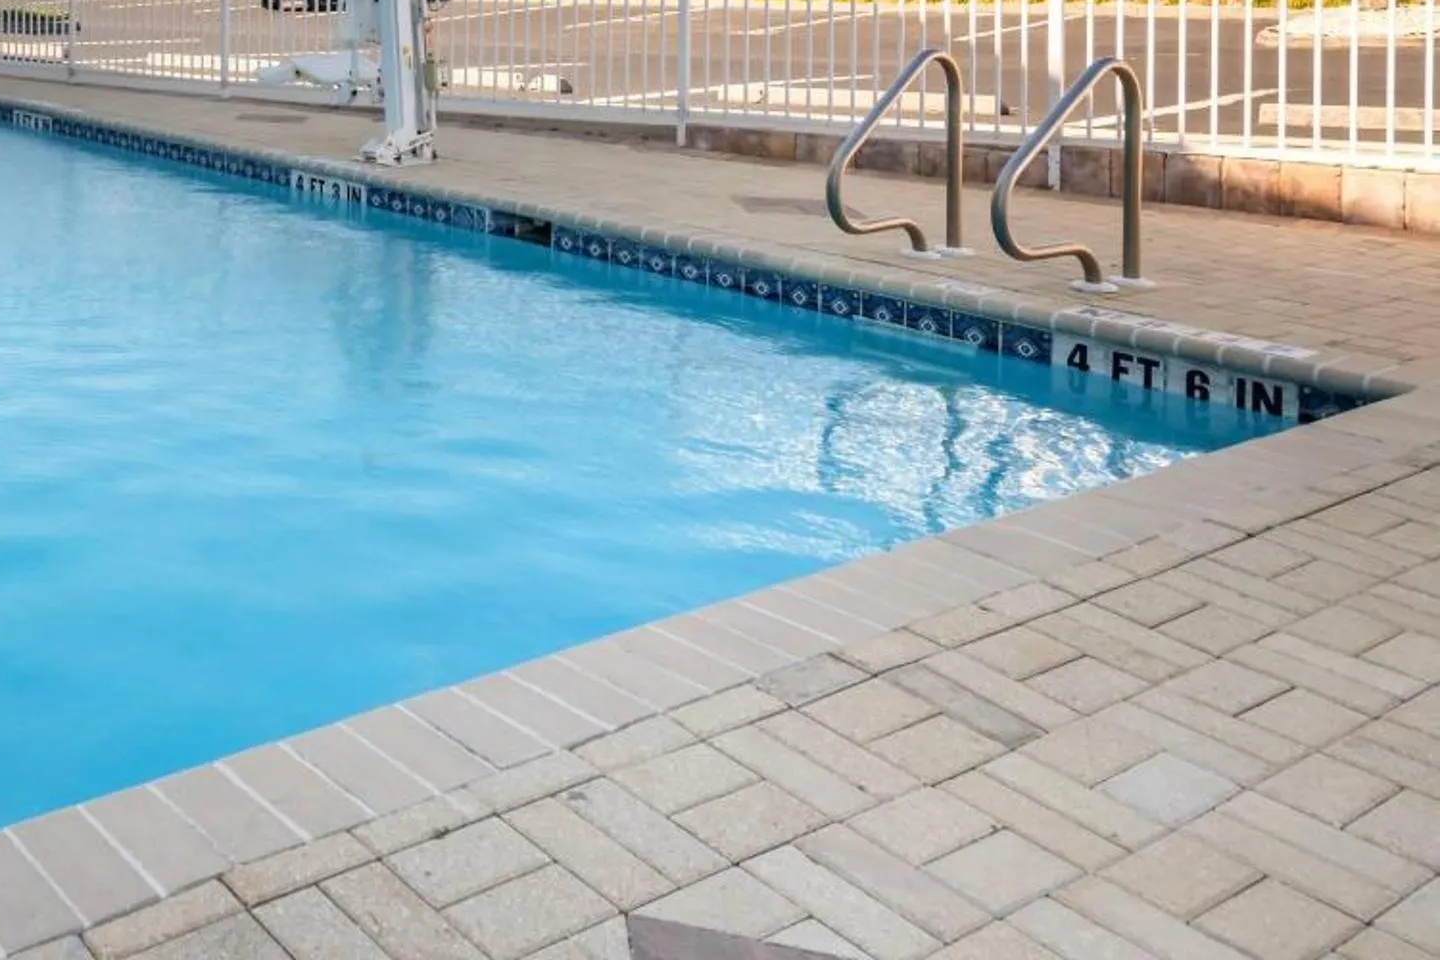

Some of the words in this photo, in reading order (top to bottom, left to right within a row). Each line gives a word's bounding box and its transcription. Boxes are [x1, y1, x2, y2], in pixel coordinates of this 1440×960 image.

[311, 178, 326, 193] FT
[346, 184, 362, 201] IN
[1066, 343, 1090, 372] 4
[1111, 351, 1160, 391] FT
[1185, 369, 1211, 401] 6
[1235, 377, 1283, 417] IN
